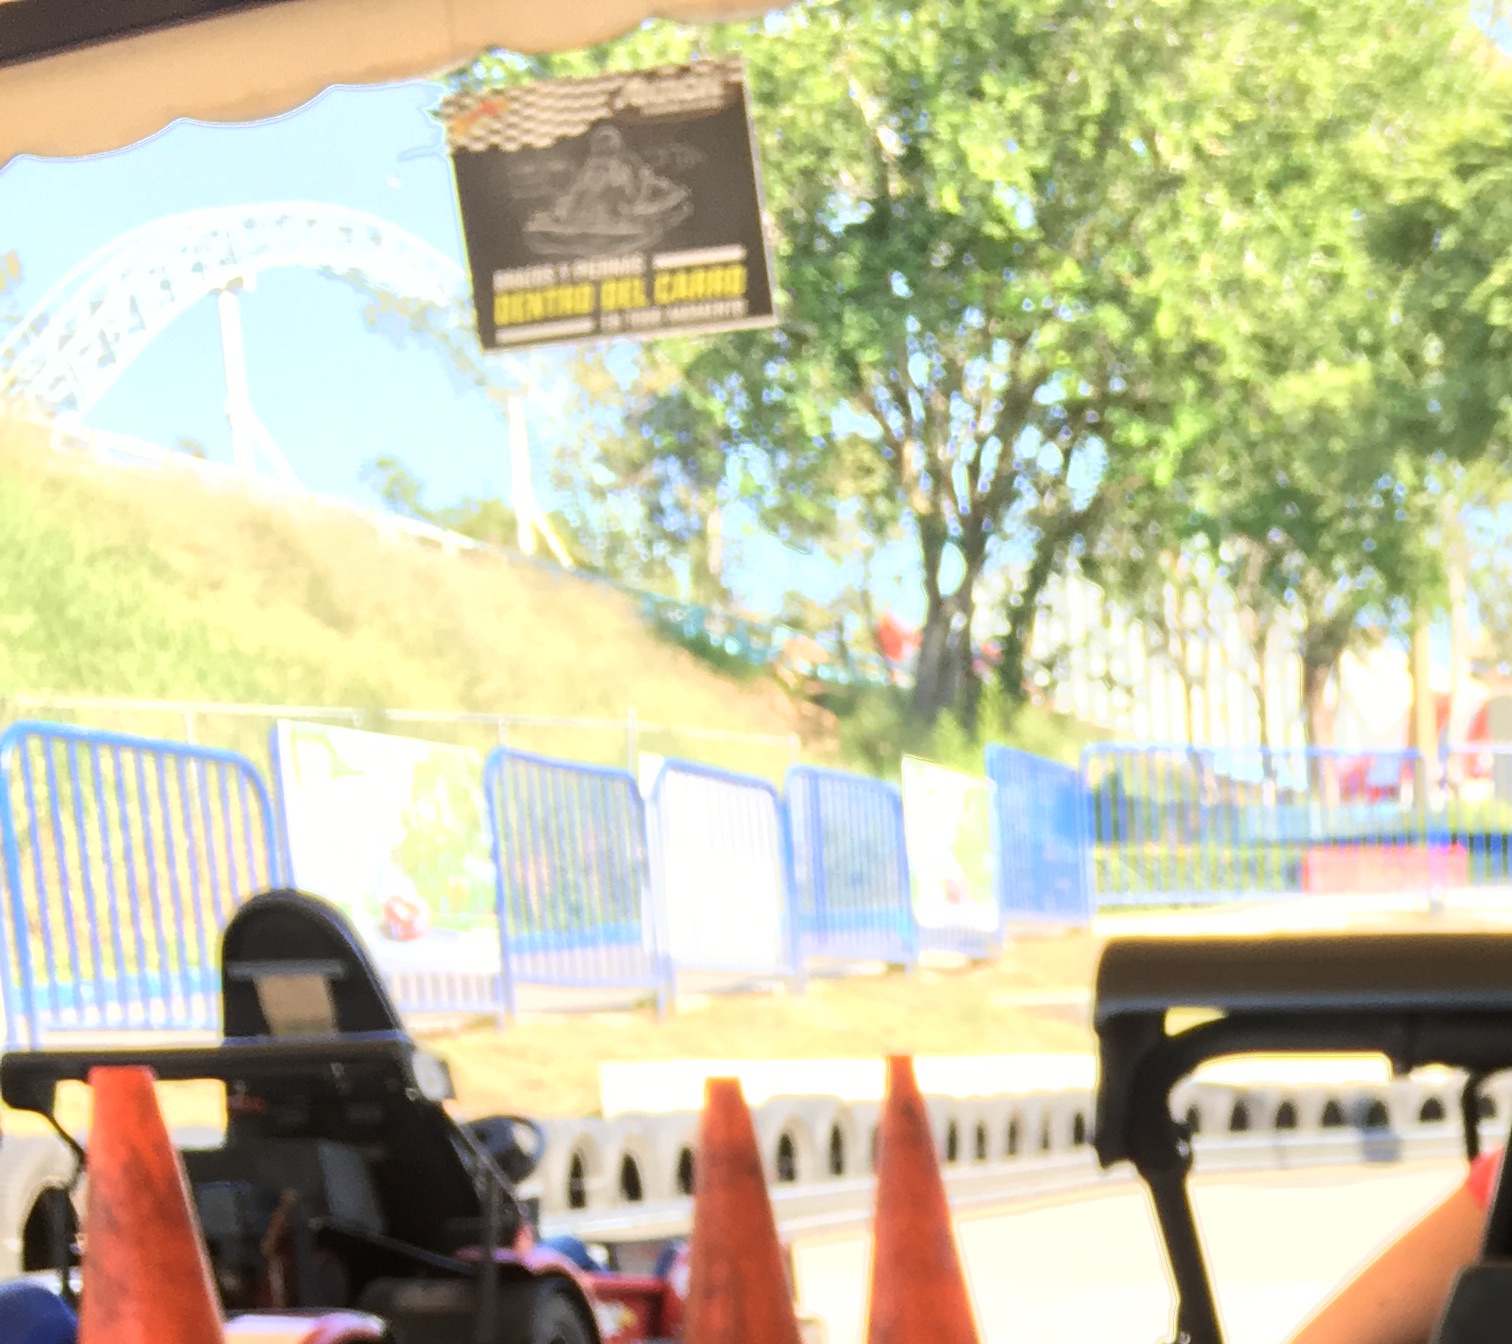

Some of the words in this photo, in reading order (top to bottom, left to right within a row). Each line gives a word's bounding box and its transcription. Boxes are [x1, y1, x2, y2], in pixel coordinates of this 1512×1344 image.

[493, 283, 595, 325] DENTRO
[599, 275, 648, 311] DEL
[653, 262, 748, 304] CARRO
